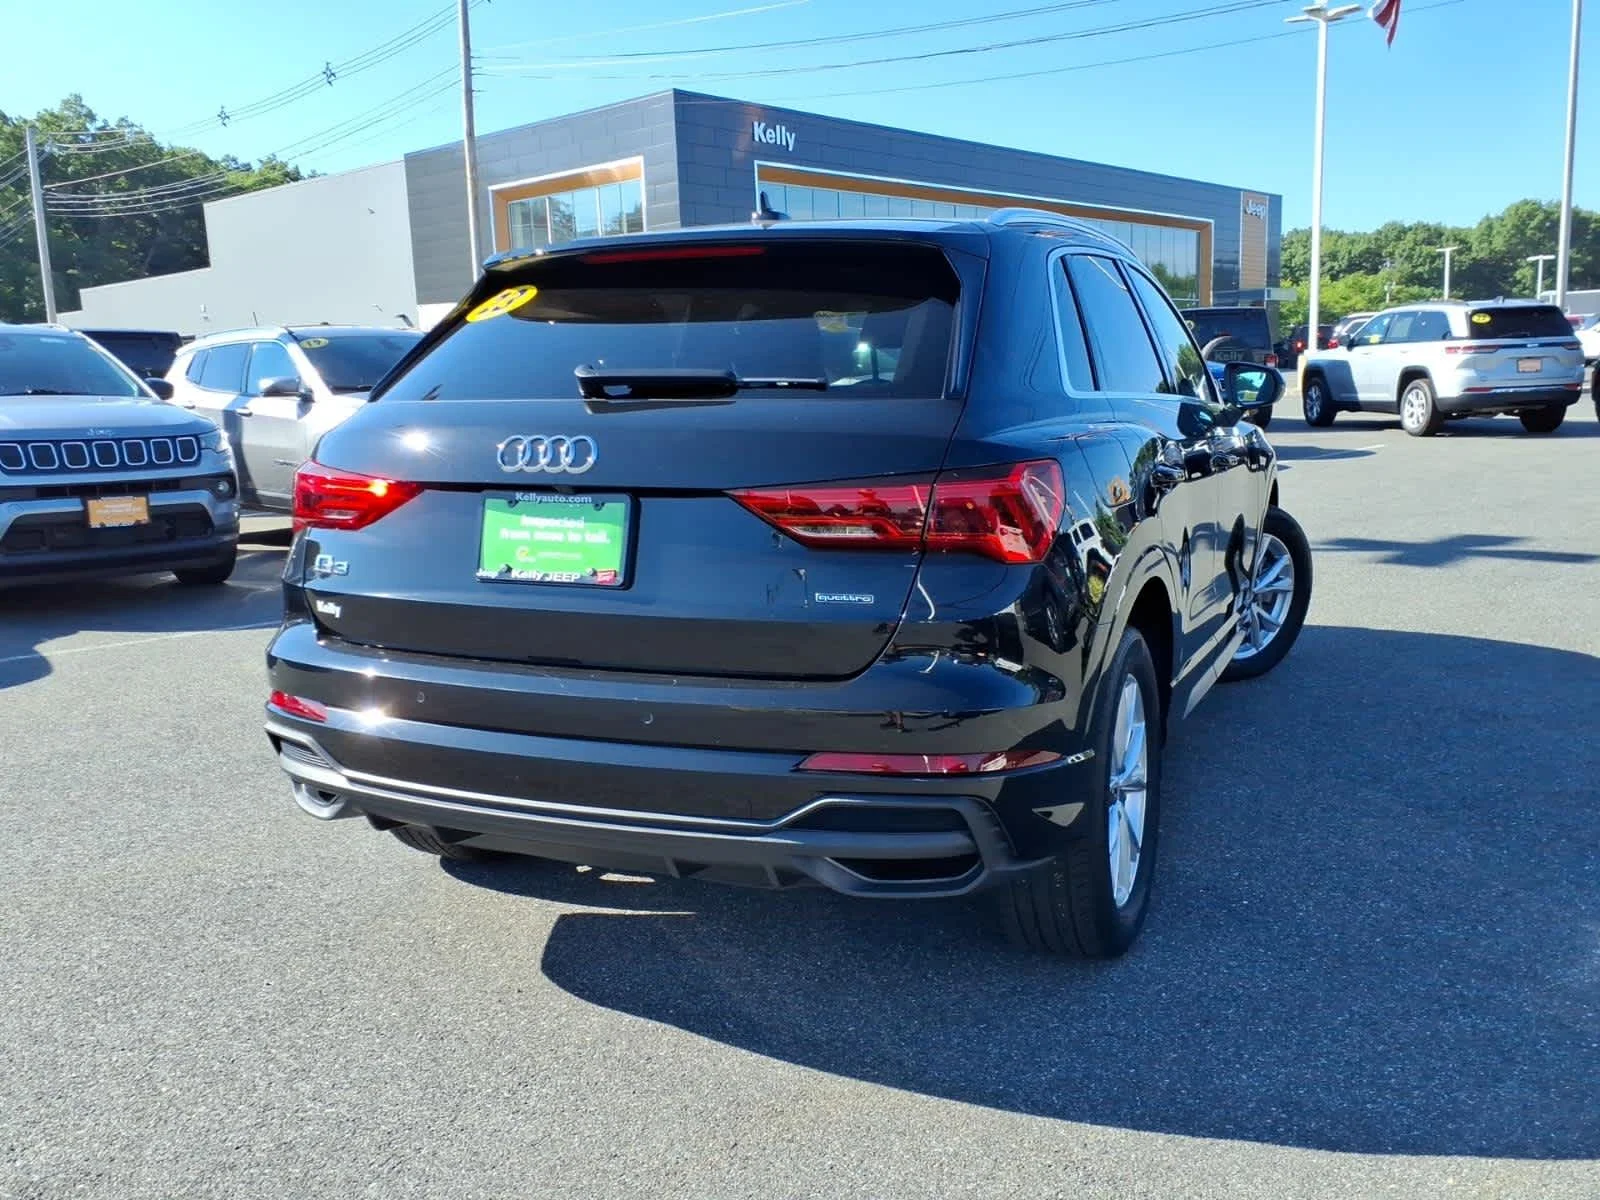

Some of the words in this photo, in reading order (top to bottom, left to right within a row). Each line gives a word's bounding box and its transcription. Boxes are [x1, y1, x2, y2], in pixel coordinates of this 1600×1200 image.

[753, 121, 796, 151] Kelly
[1246, 200, 1266, 219] Jeep
[515, 492, 592, 504] Kellyauto.com
[313, 554, 348, 574] Q3
[511, 568, 544, 581] Kelly
[545, 572, 581, 582] JEEP
[817, 594, 873, 603] quattro
[316, 600, 341, 618] Kelly
